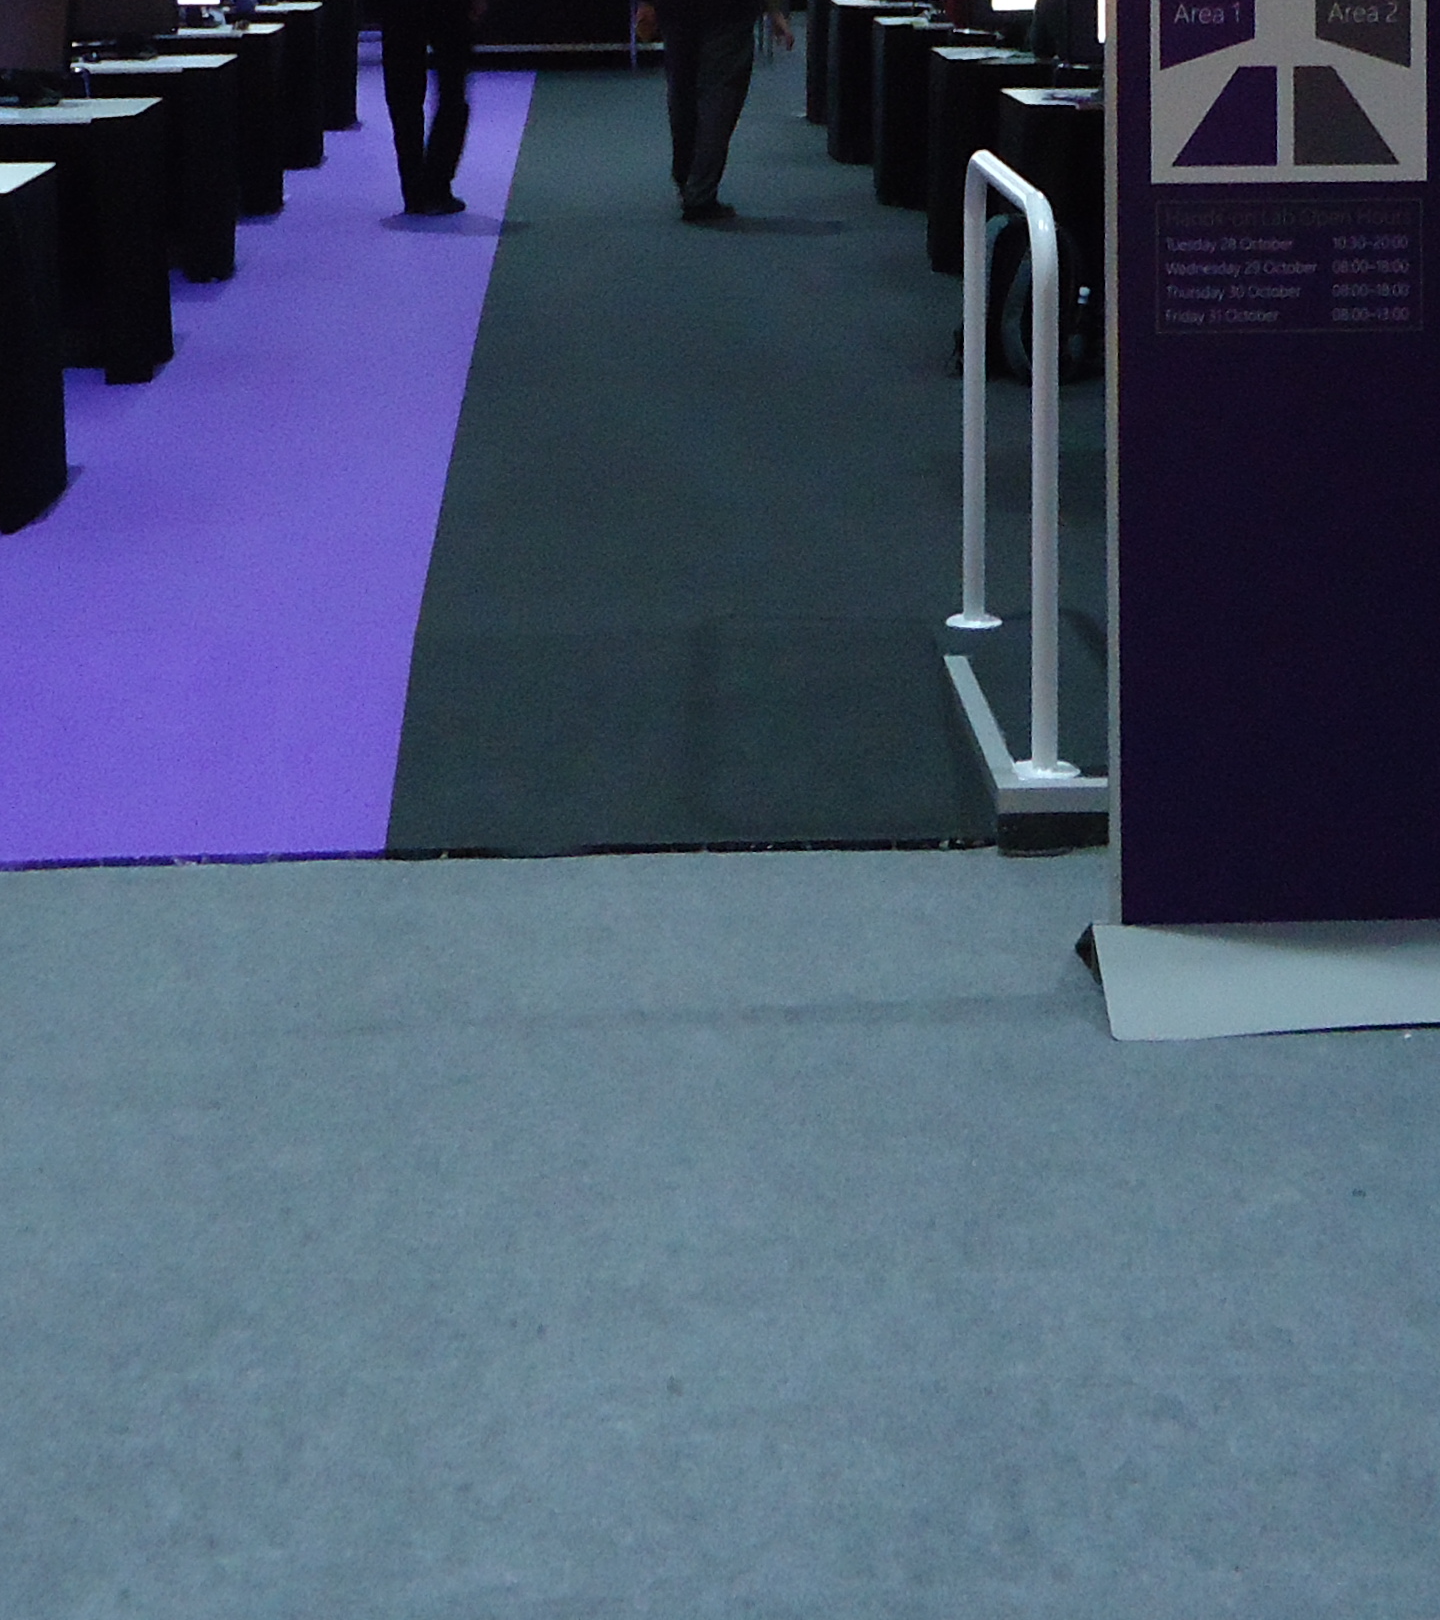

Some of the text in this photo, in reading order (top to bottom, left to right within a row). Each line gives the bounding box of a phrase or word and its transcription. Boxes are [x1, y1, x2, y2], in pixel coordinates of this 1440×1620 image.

[1173, 2, 1242, 25] Area 1
[1327, 2, 1398, 24] Area 2
[1262, 260, 1318, 275] October
[1248, 284, 1302, 299] October
[1165, 308, 1206, 325] Friday
[1224, 308, 1280, 322] October
